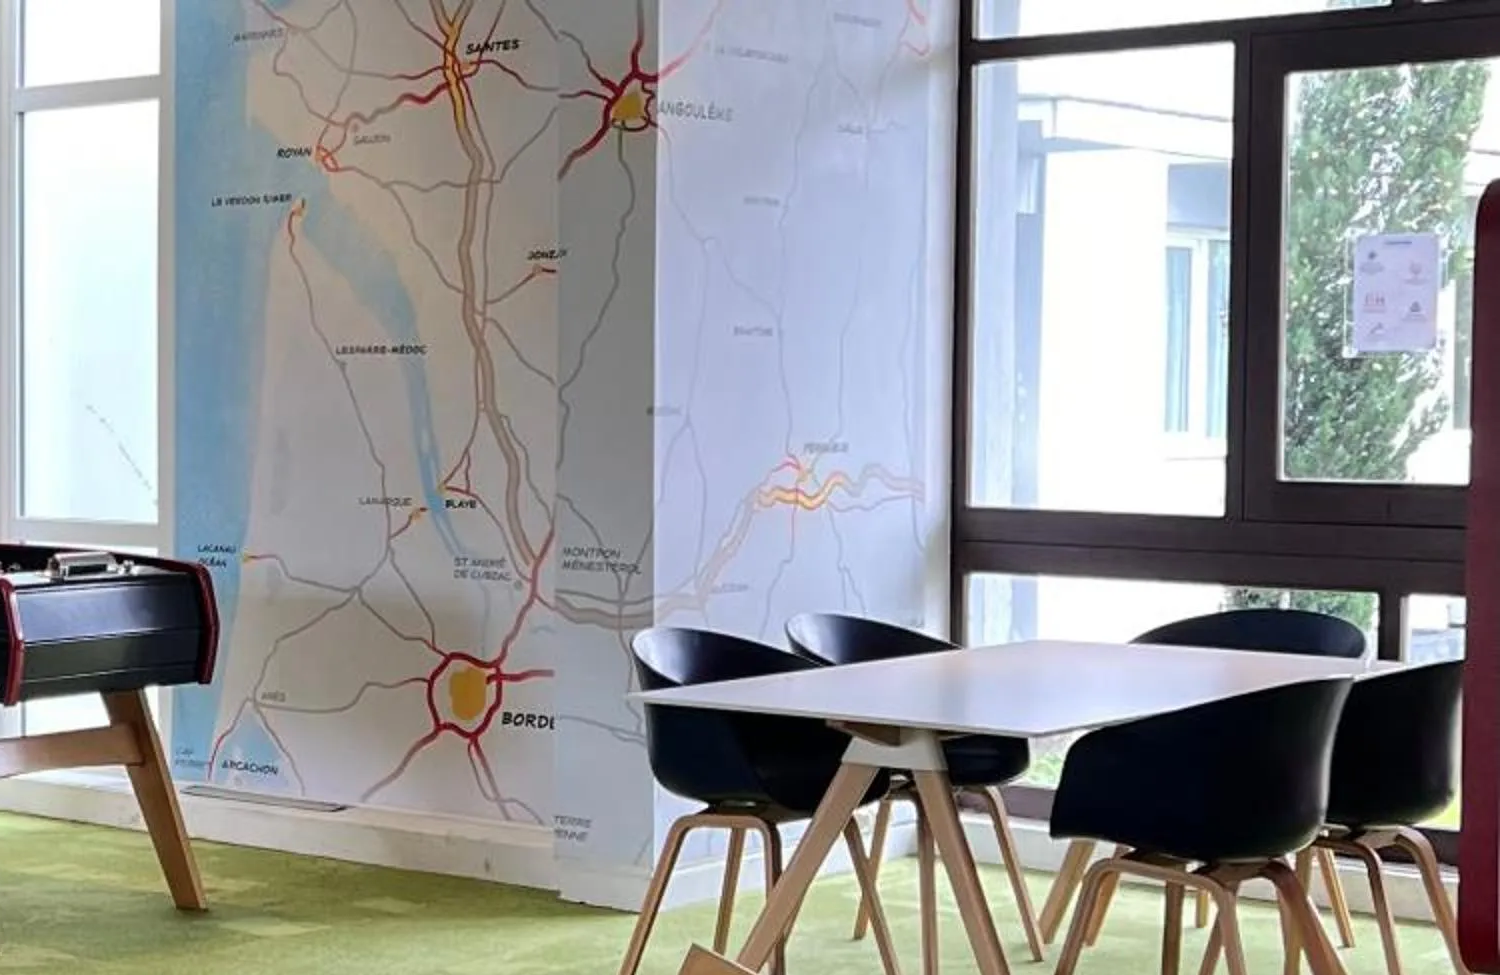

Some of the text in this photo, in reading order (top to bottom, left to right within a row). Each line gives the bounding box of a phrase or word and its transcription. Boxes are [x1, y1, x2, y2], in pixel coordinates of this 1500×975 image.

[466, 39, 520, 55] SAINTES
[276, 148, 312, 159] ROYAN
[445, 499, 477, 509] BLAYE
[221, 759, 278, 775] ARCACHON
